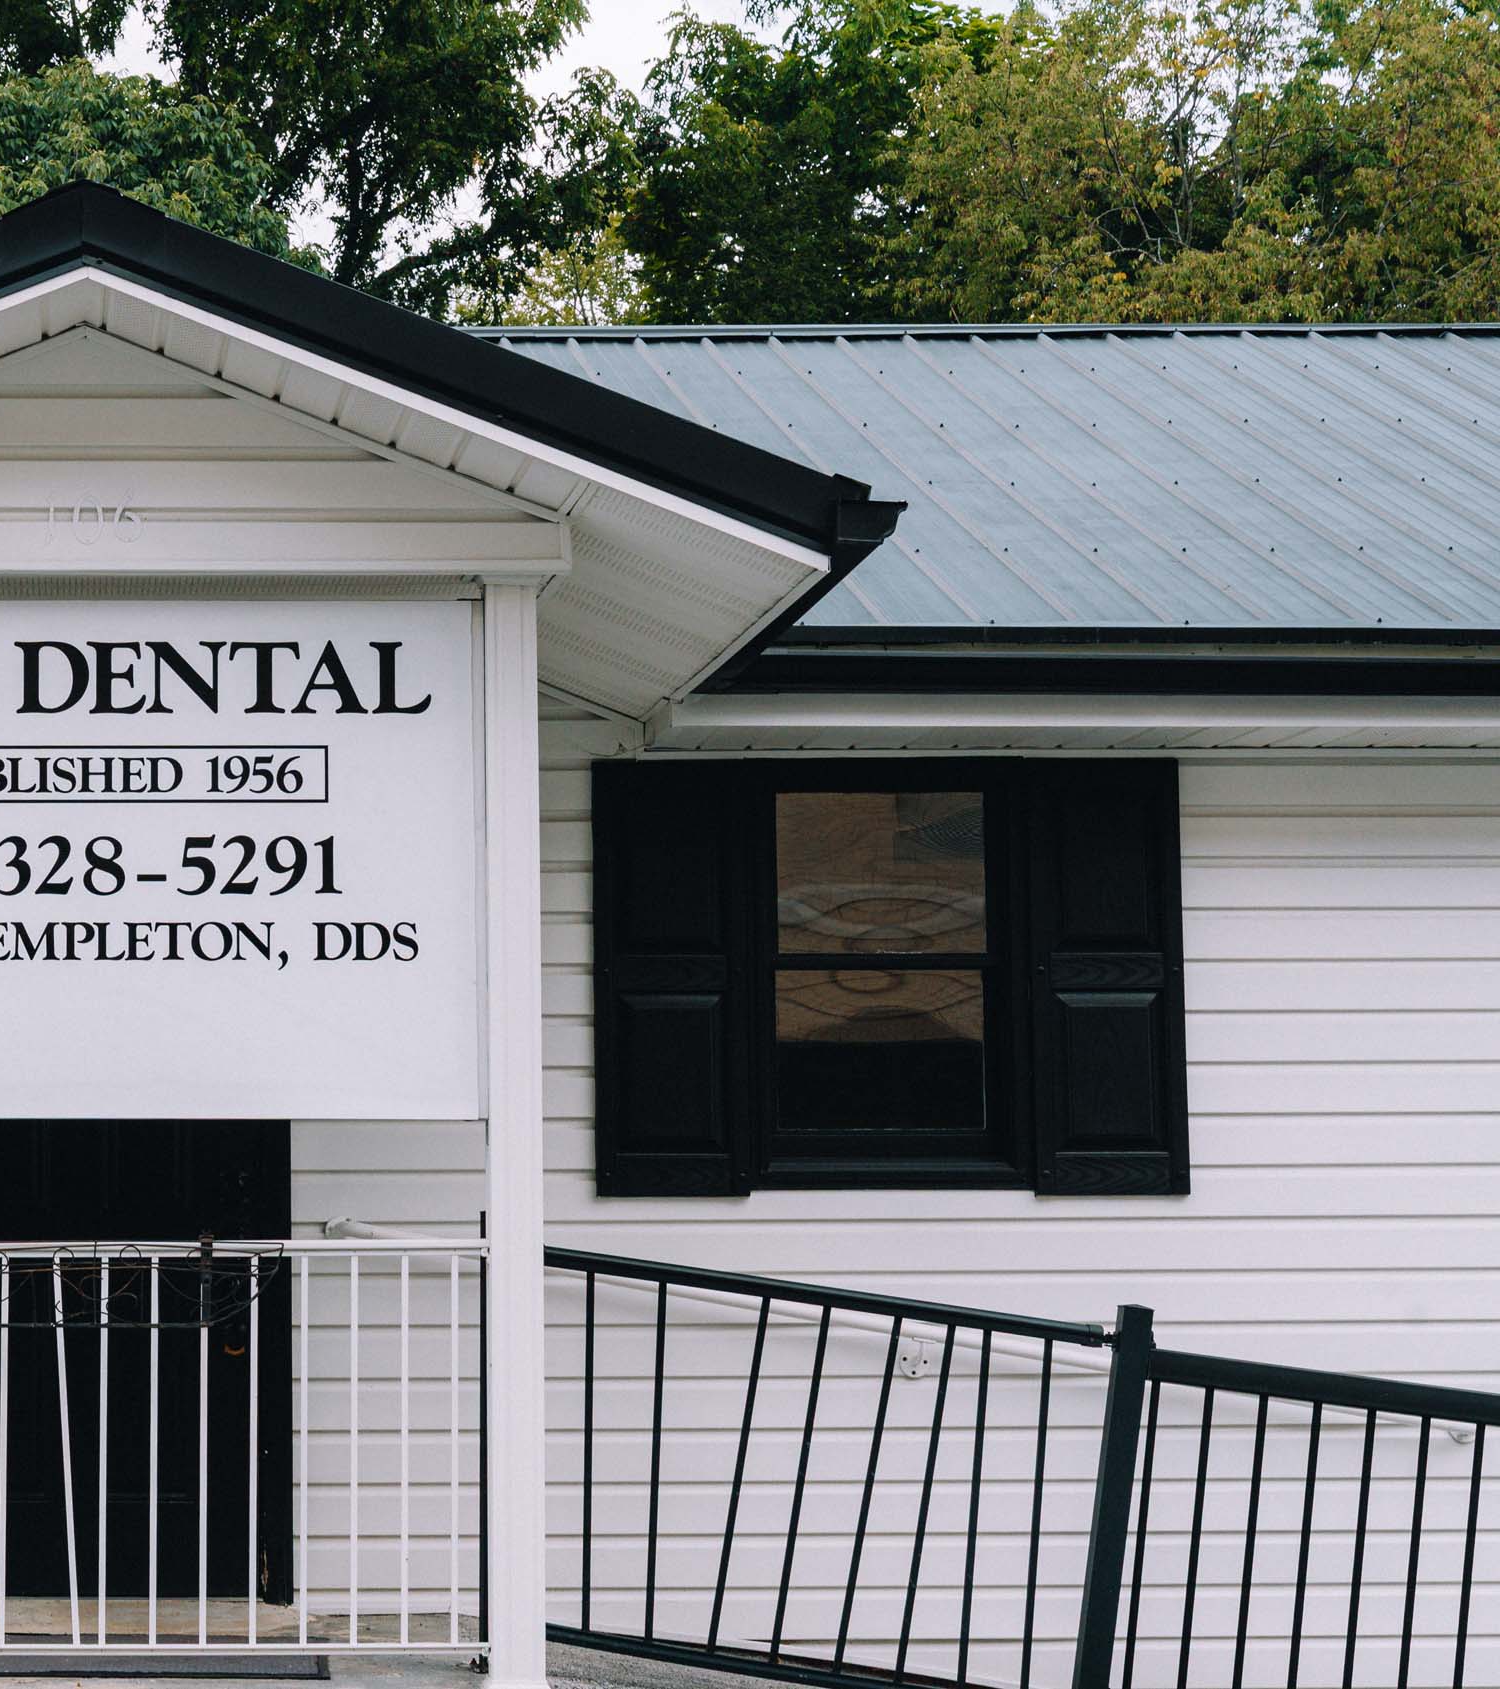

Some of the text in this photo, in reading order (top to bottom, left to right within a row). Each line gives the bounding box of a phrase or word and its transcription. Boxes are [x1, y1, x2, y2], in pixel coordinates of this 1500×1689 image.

[45, 491, 142, 544] 106
[14, 640, 432, 715] DENTAL
[206, 755, 304, 794] 1956
[312, 921, 420, 962] DDS
